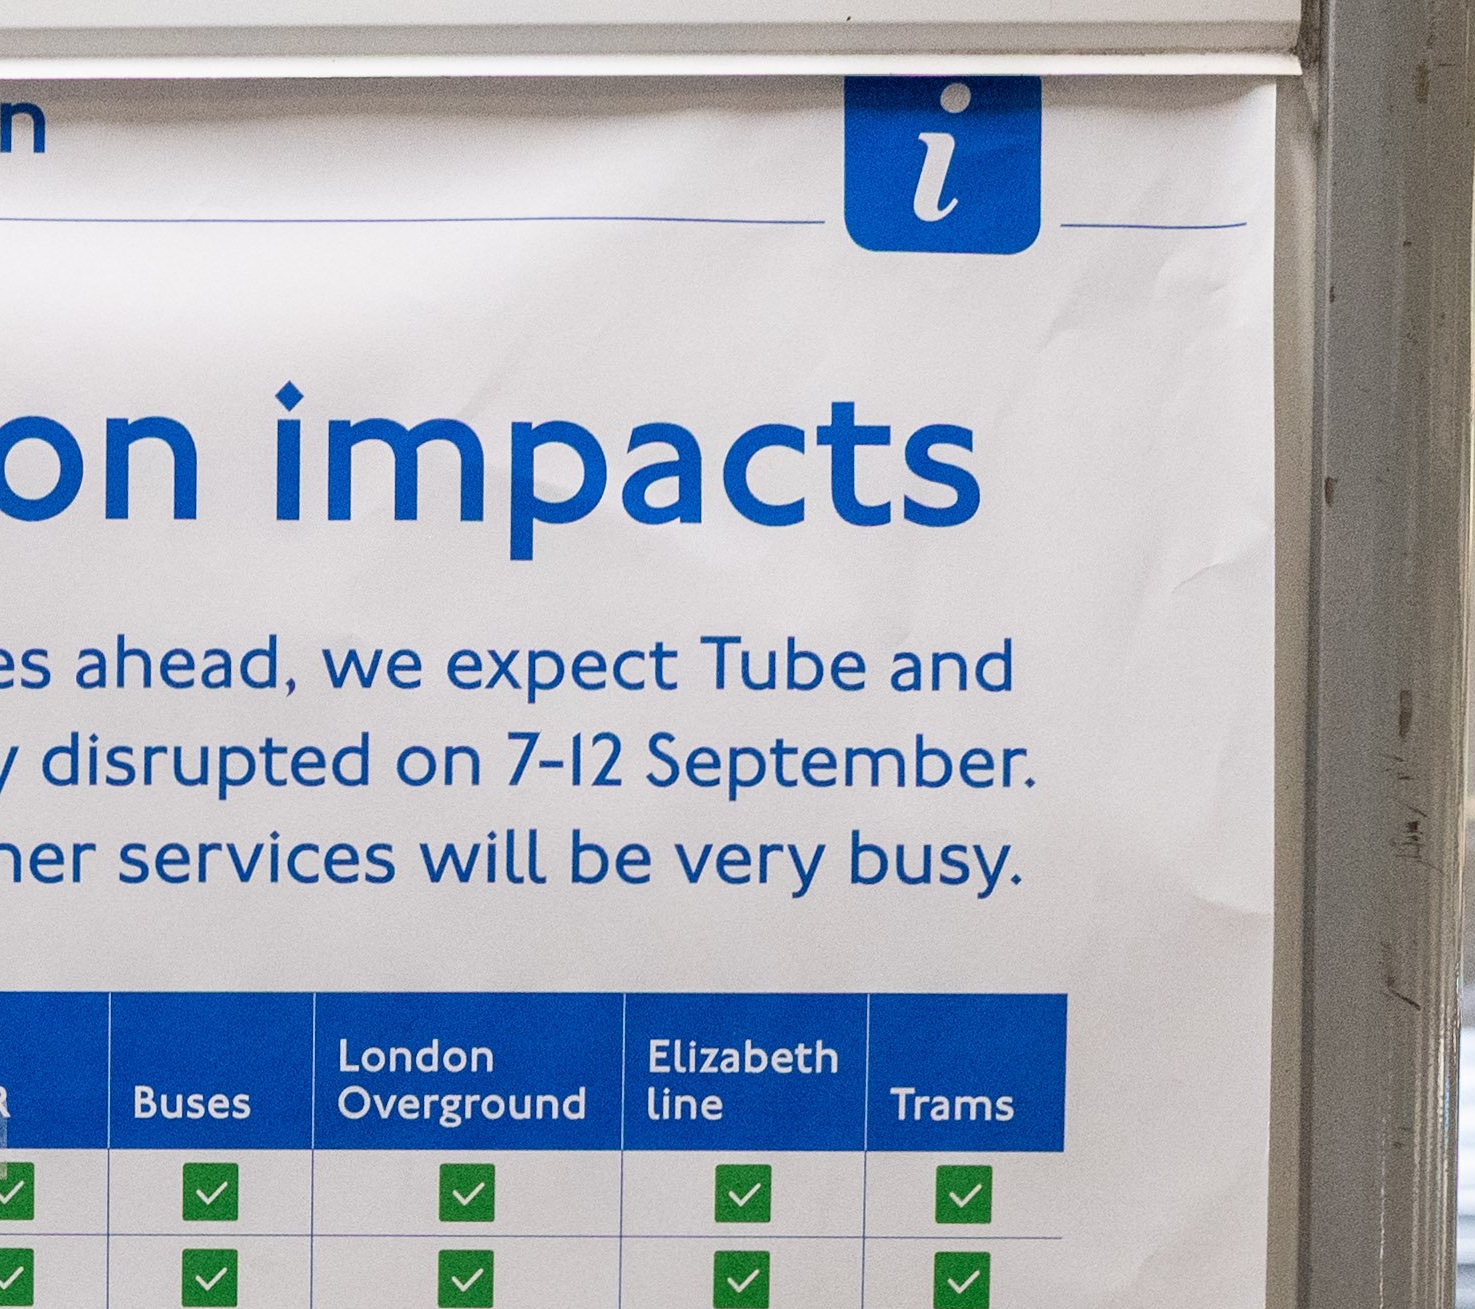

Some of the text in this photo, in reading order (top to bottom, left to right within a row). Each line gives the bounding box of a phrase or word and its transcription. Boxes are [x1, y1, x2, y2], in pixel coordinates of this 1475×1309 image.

[277, 383, 980, 560] impacts
[77, 634, 295, 691] ahead,
[323, 649, 422, 689] we
[447, 642, 677, 703] expect
[701, 636, 866, 691] Tube
[891, 639, 1012, 692] and
[43, 732, 369, 800] disrupted
[397, 746, 480, 787] on
[509, 731, 621, 786] 7-12
[648, 732, 1033, 800] September.
[340, 1039, 493, 1072] London
[650, 1040, 837, 1073] Elizabeth
[135, 1086, 250, 1118] Buses
[339, 1086, 585, 1127] Overground
[648, 1087, 722, 1120] line
[891, 1088, 1013, 1120] Trams
